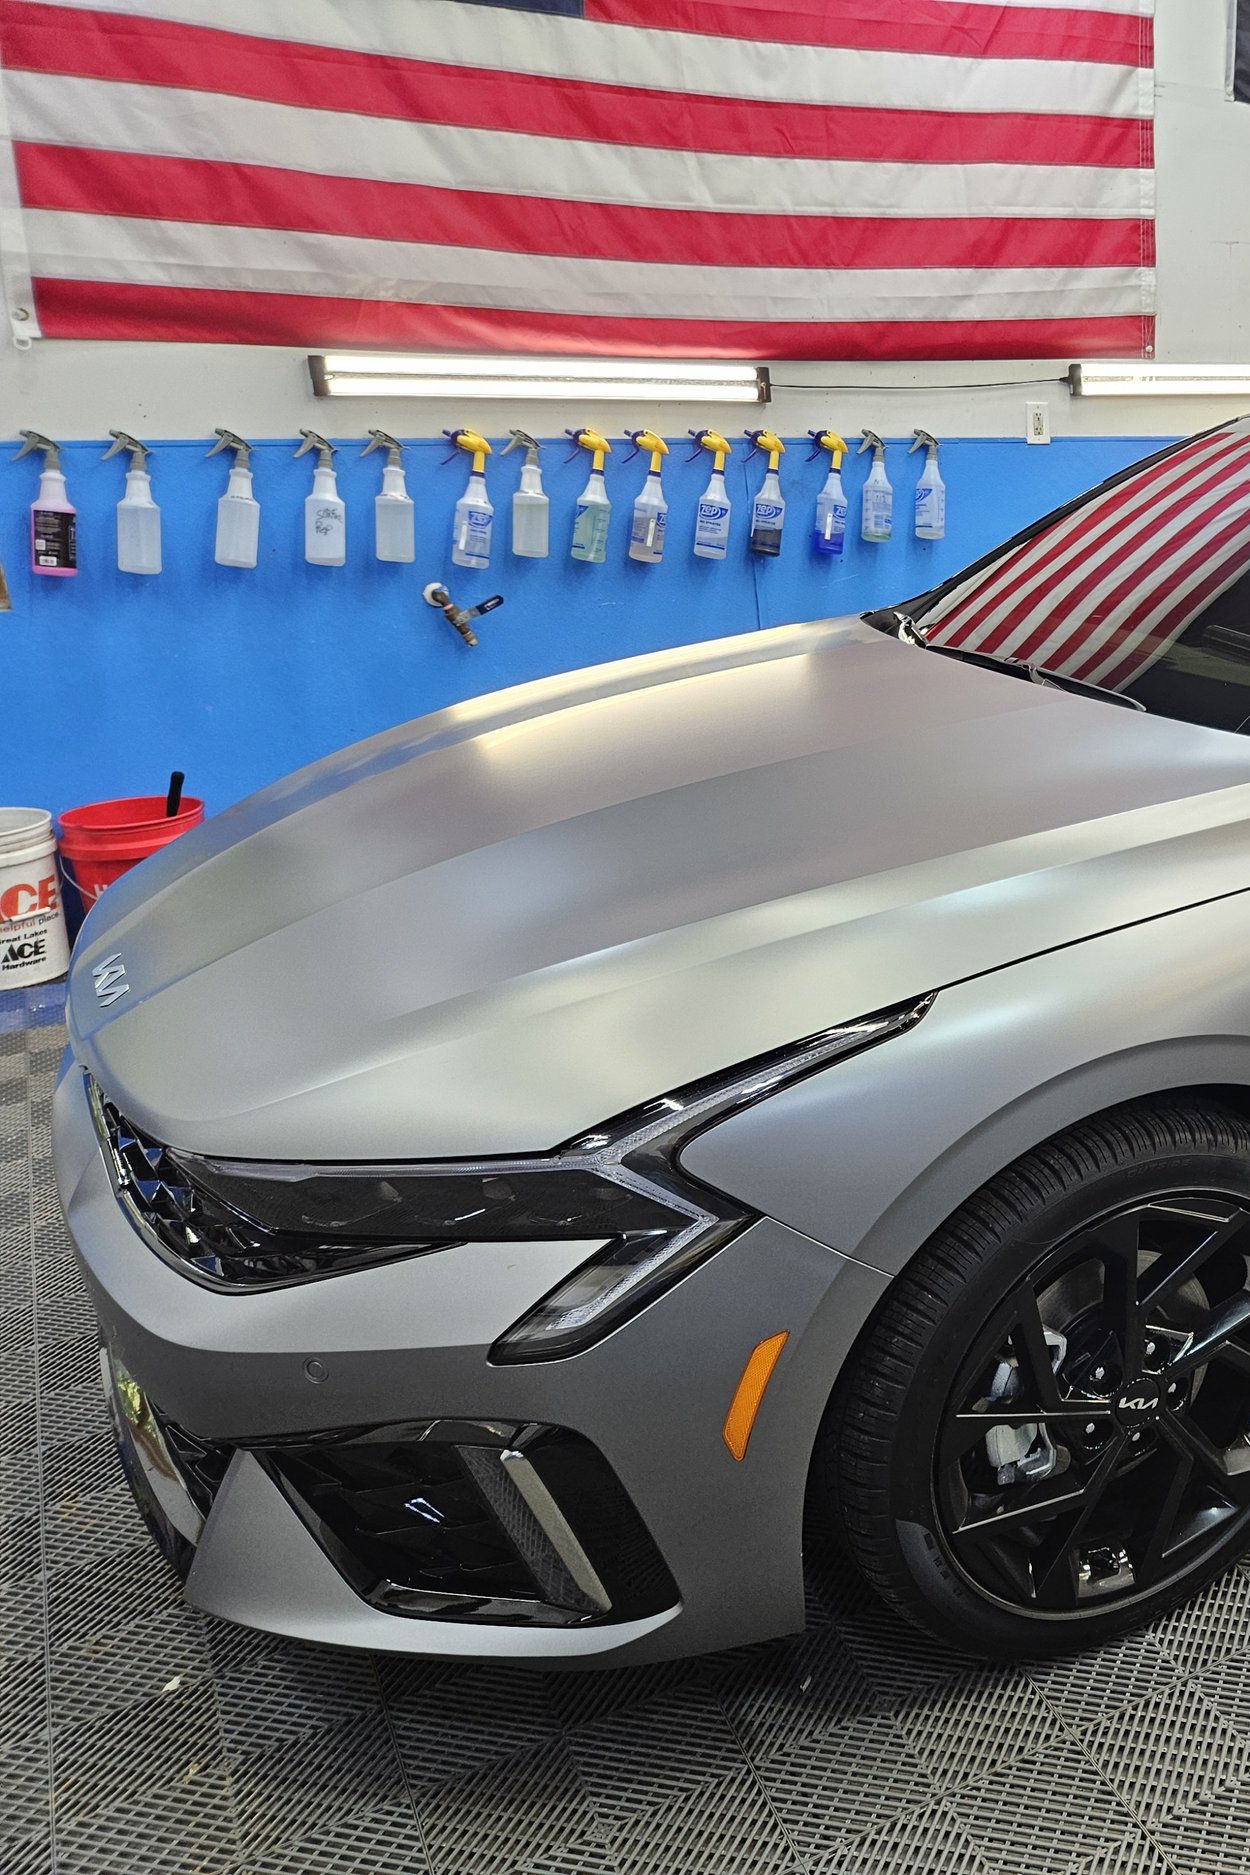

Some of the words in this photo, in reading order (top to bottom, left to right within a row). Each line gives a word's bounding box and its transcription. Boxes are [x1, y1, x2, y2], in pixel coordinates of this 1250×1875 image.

[0, 874, 58, 925] CE
[38, 911, 60, 926] place
[24, 928, 48, 940] Lakes
[1, 938, 47, 964] ACE
[1, 955, 47, 972] Hardware
